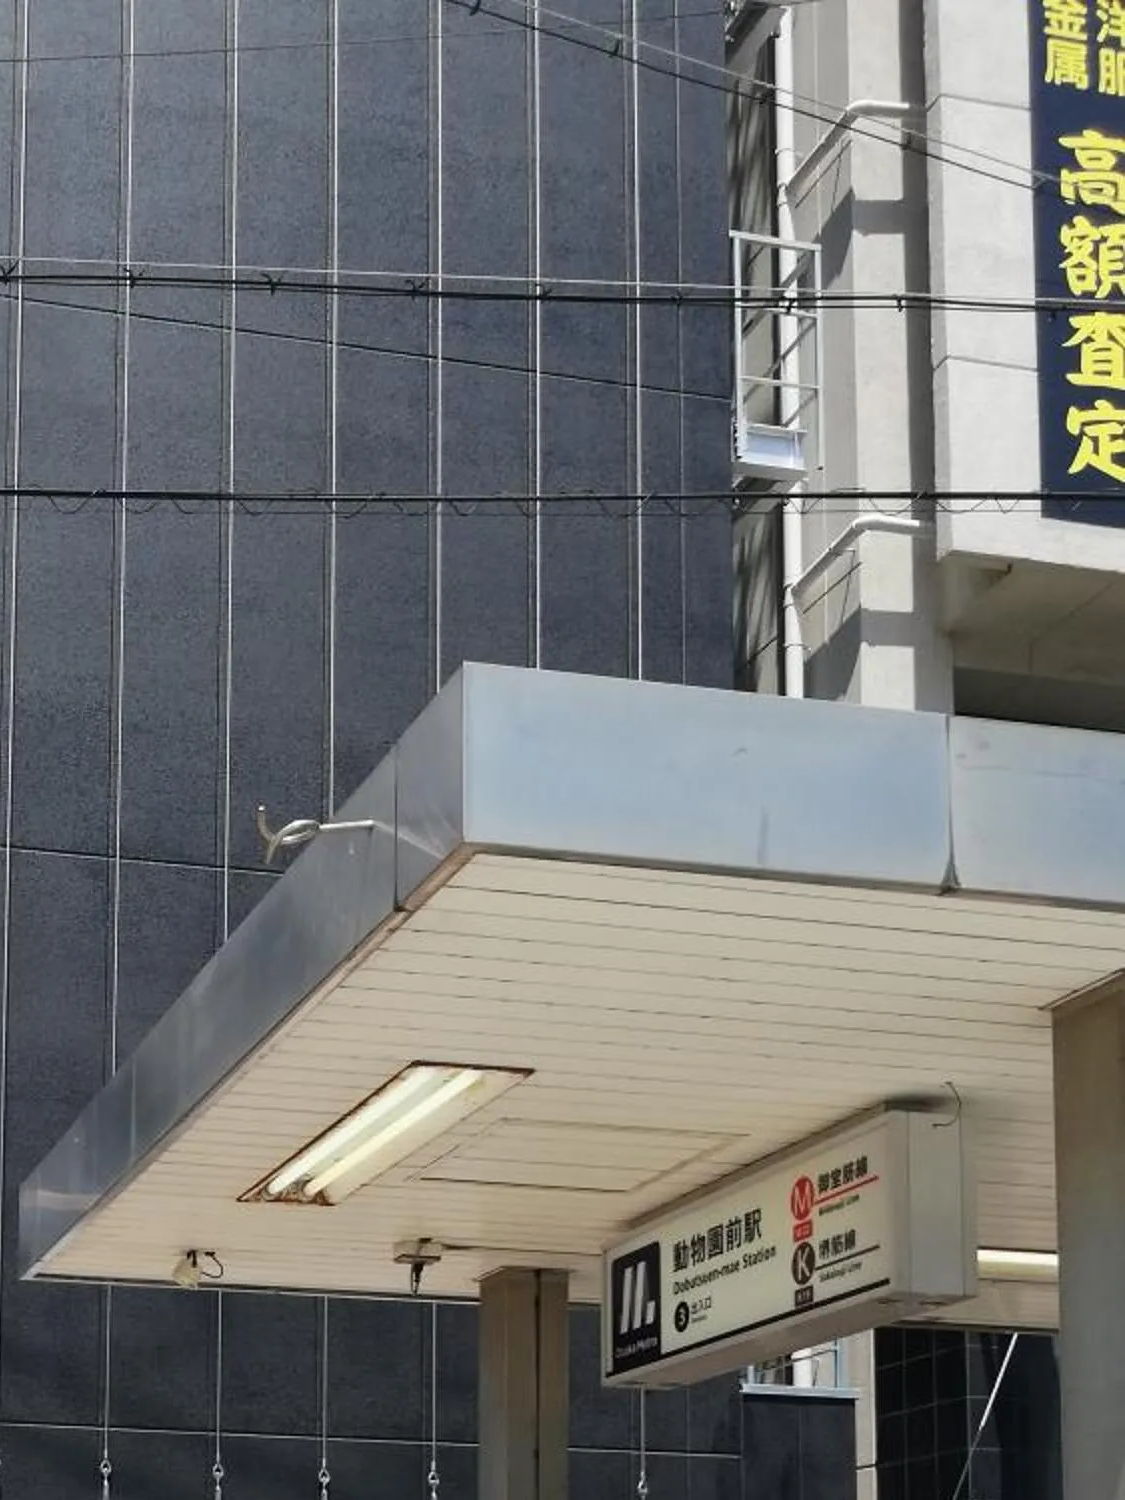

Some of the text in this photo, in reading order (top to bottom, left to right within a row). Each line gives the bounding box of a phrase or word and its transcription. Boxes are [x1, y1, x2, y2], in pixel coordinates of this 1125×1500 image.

[1058, 129, 1125, 484] 高額査定
[673, 1208, 762, 1273] 動物園前駅
[743, 1246, 777, 1269] Station
